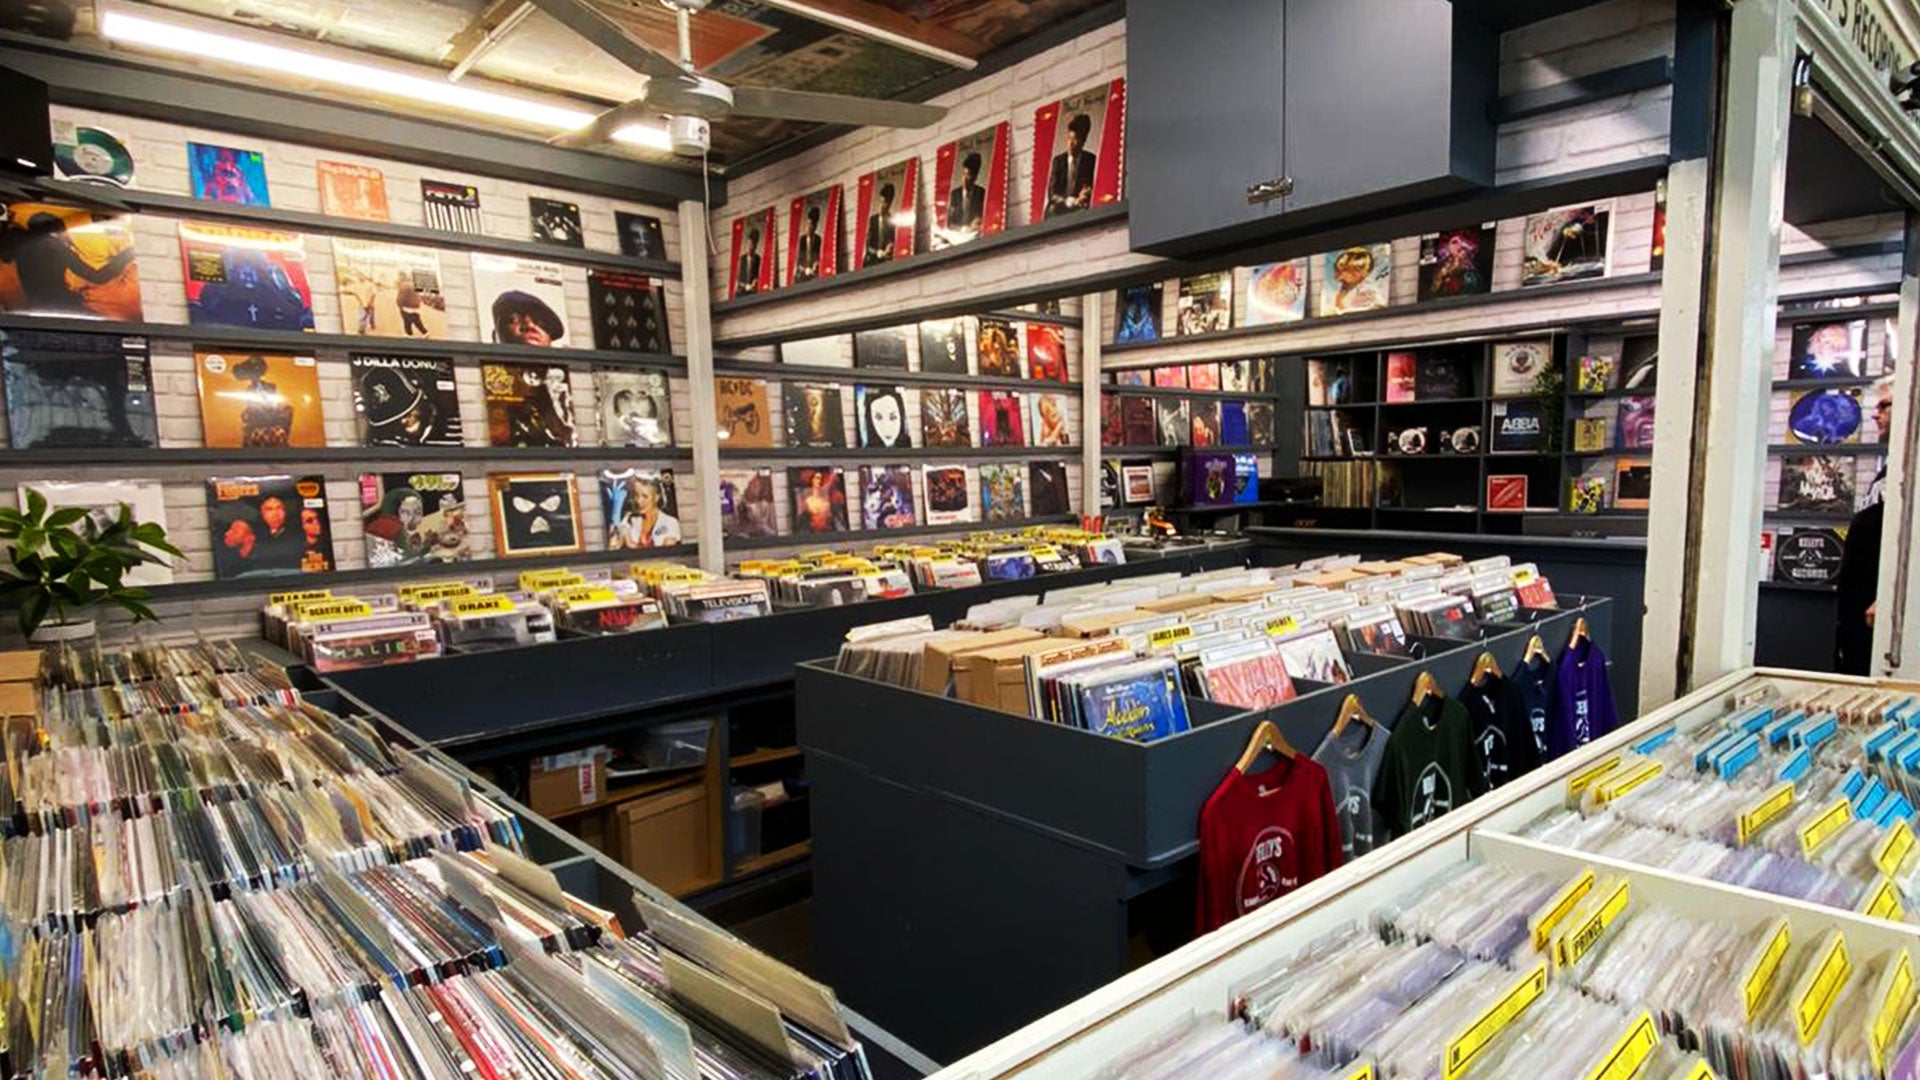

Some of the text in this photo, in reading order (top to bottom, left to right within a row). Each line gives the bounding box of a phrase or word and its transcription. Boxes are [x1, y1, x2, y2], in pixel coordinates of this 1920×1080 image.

[363, 357, 401, 368] DILLA
[1501, 417, 1540, 432] ABBA
[1573, 914, 1604, 958] PRINCE
